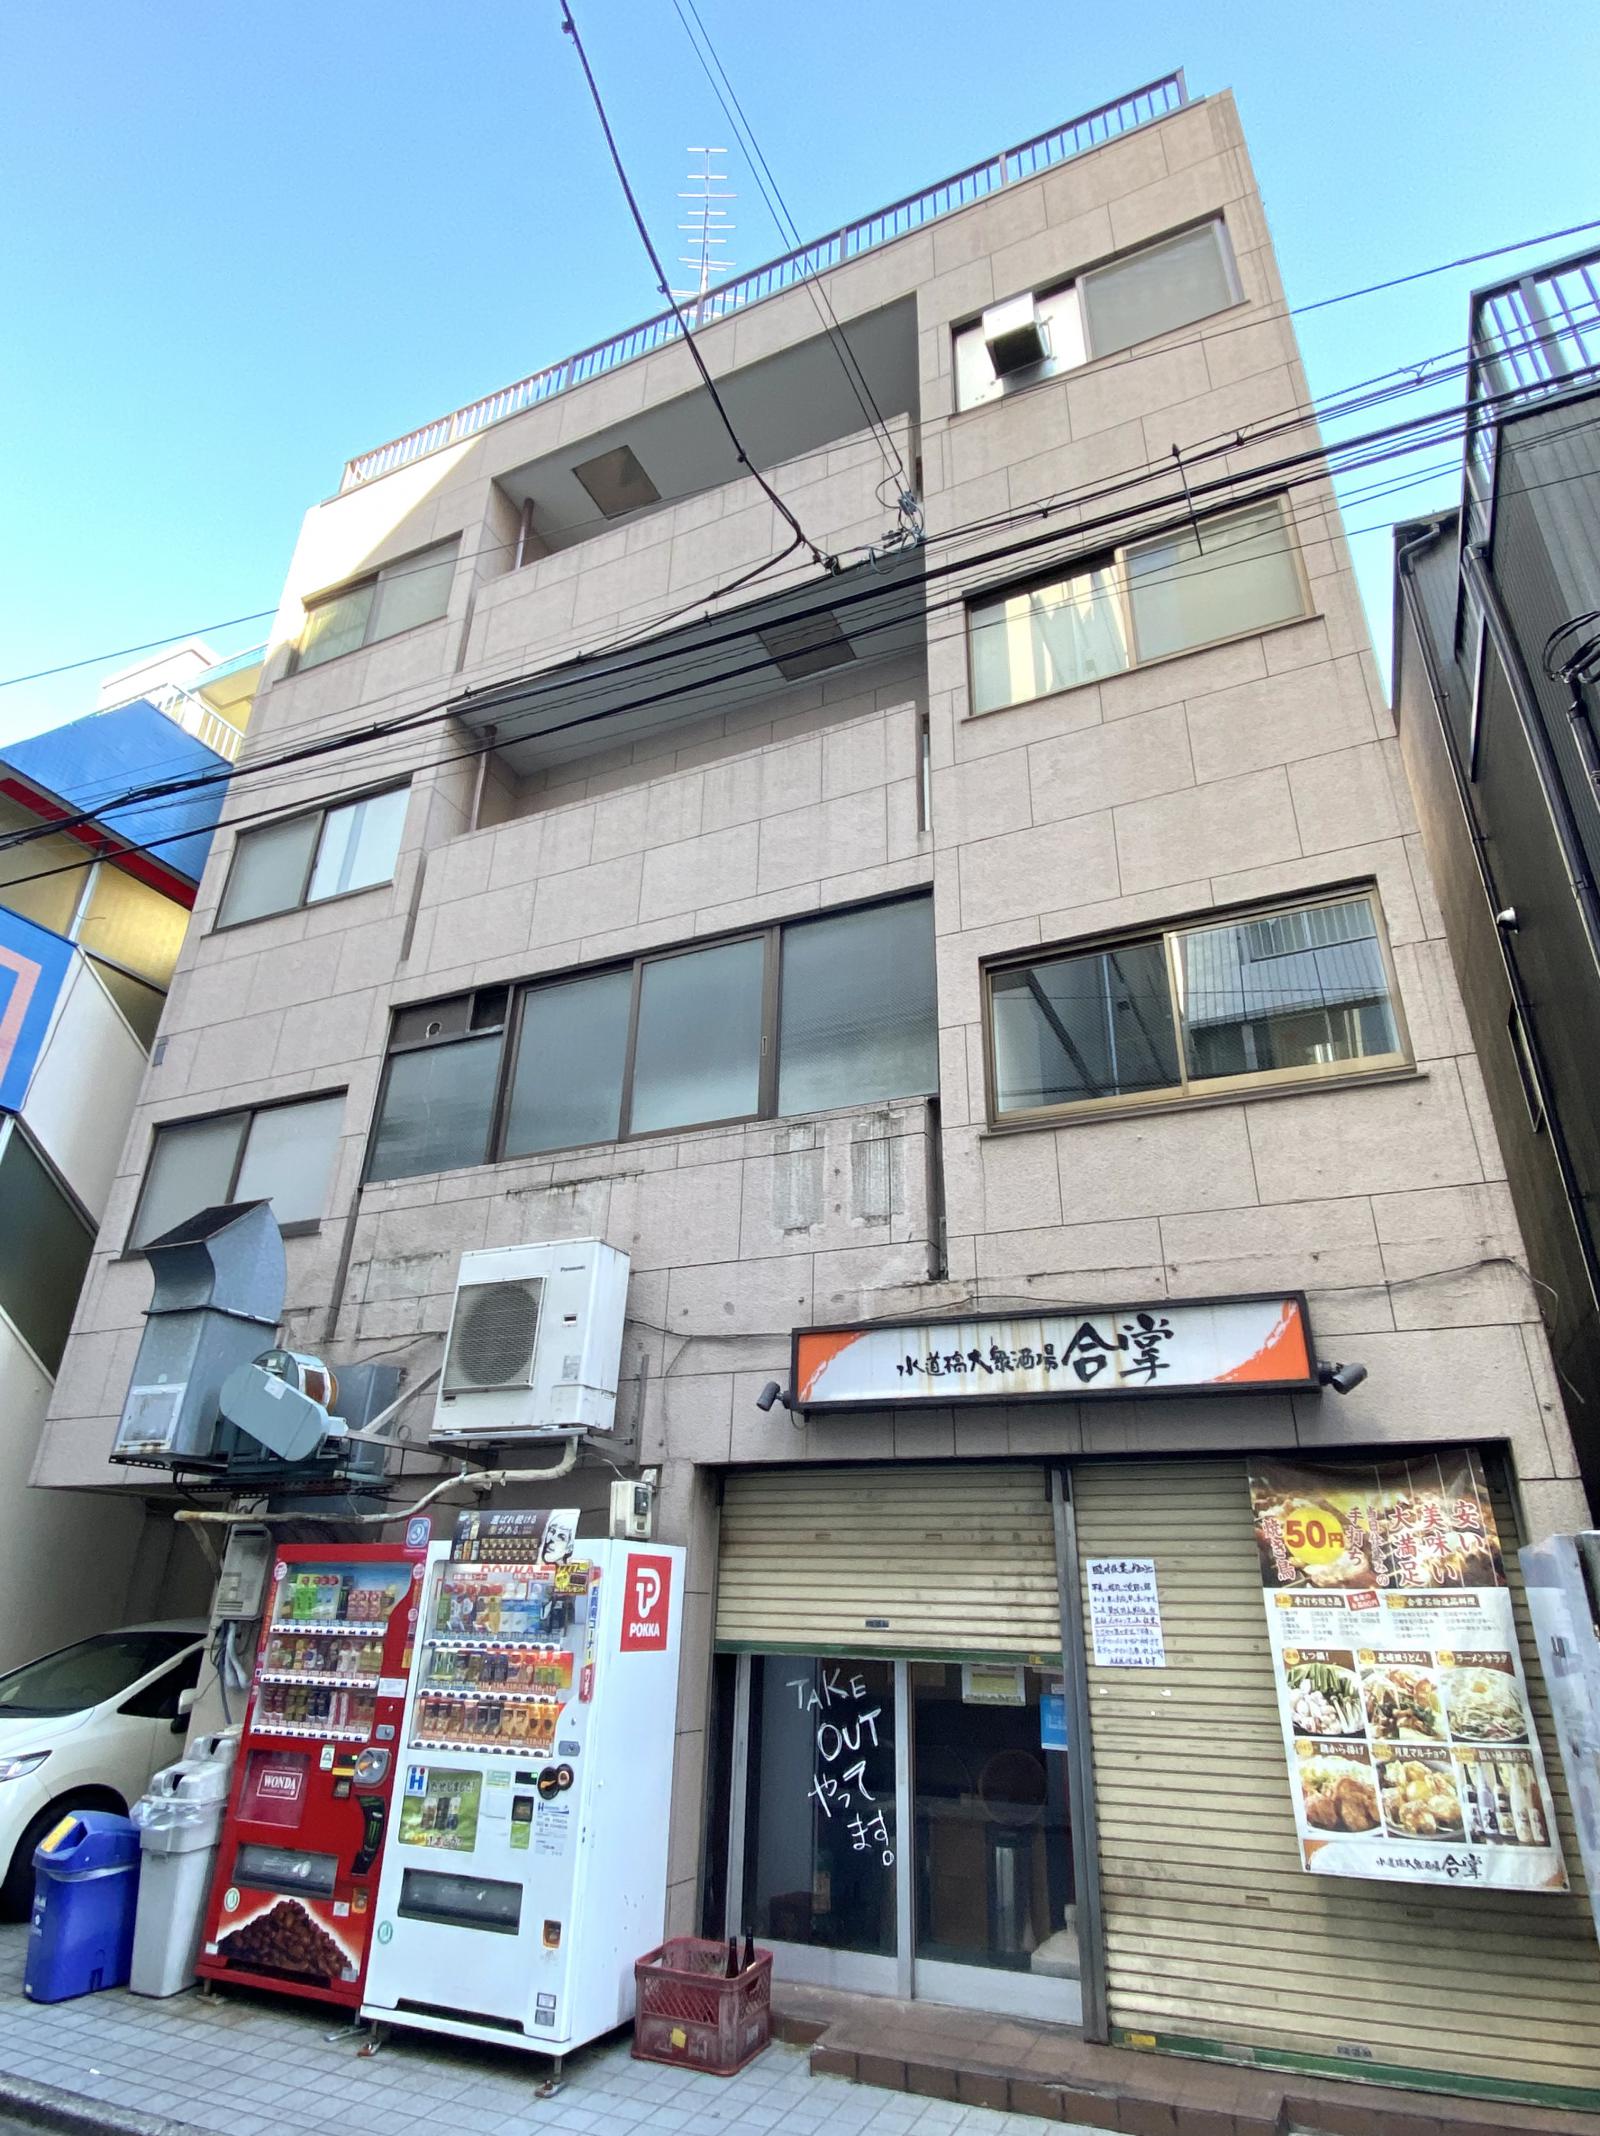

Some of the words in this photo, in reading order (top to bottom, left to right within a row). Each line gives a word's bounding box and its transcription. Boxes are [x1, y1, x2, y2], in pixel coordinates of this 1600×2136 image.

[896, 1337, 1058, 1377] 水道橋大衆酒場
[1262, 1517, 1297, 1583] 焼き鳥
[1286, 1519, 1345, 1549] 50円
[1388, 1504, 1426, 1588] 大満足
[1422, 1503, 1459, 1584] 美味い
[1450, 1499, 1488, 1554] 安い
[629, 1622, 661, 1638] POKKA
[785, 1668, 867, 1711] TAKE
[817, 1708, 882, 1762] OUT
[264, 1774, 296, 1790] WONDA
[807, 1760, 876, 1818] やって
[847, 1809, 895, 1866] ます。
